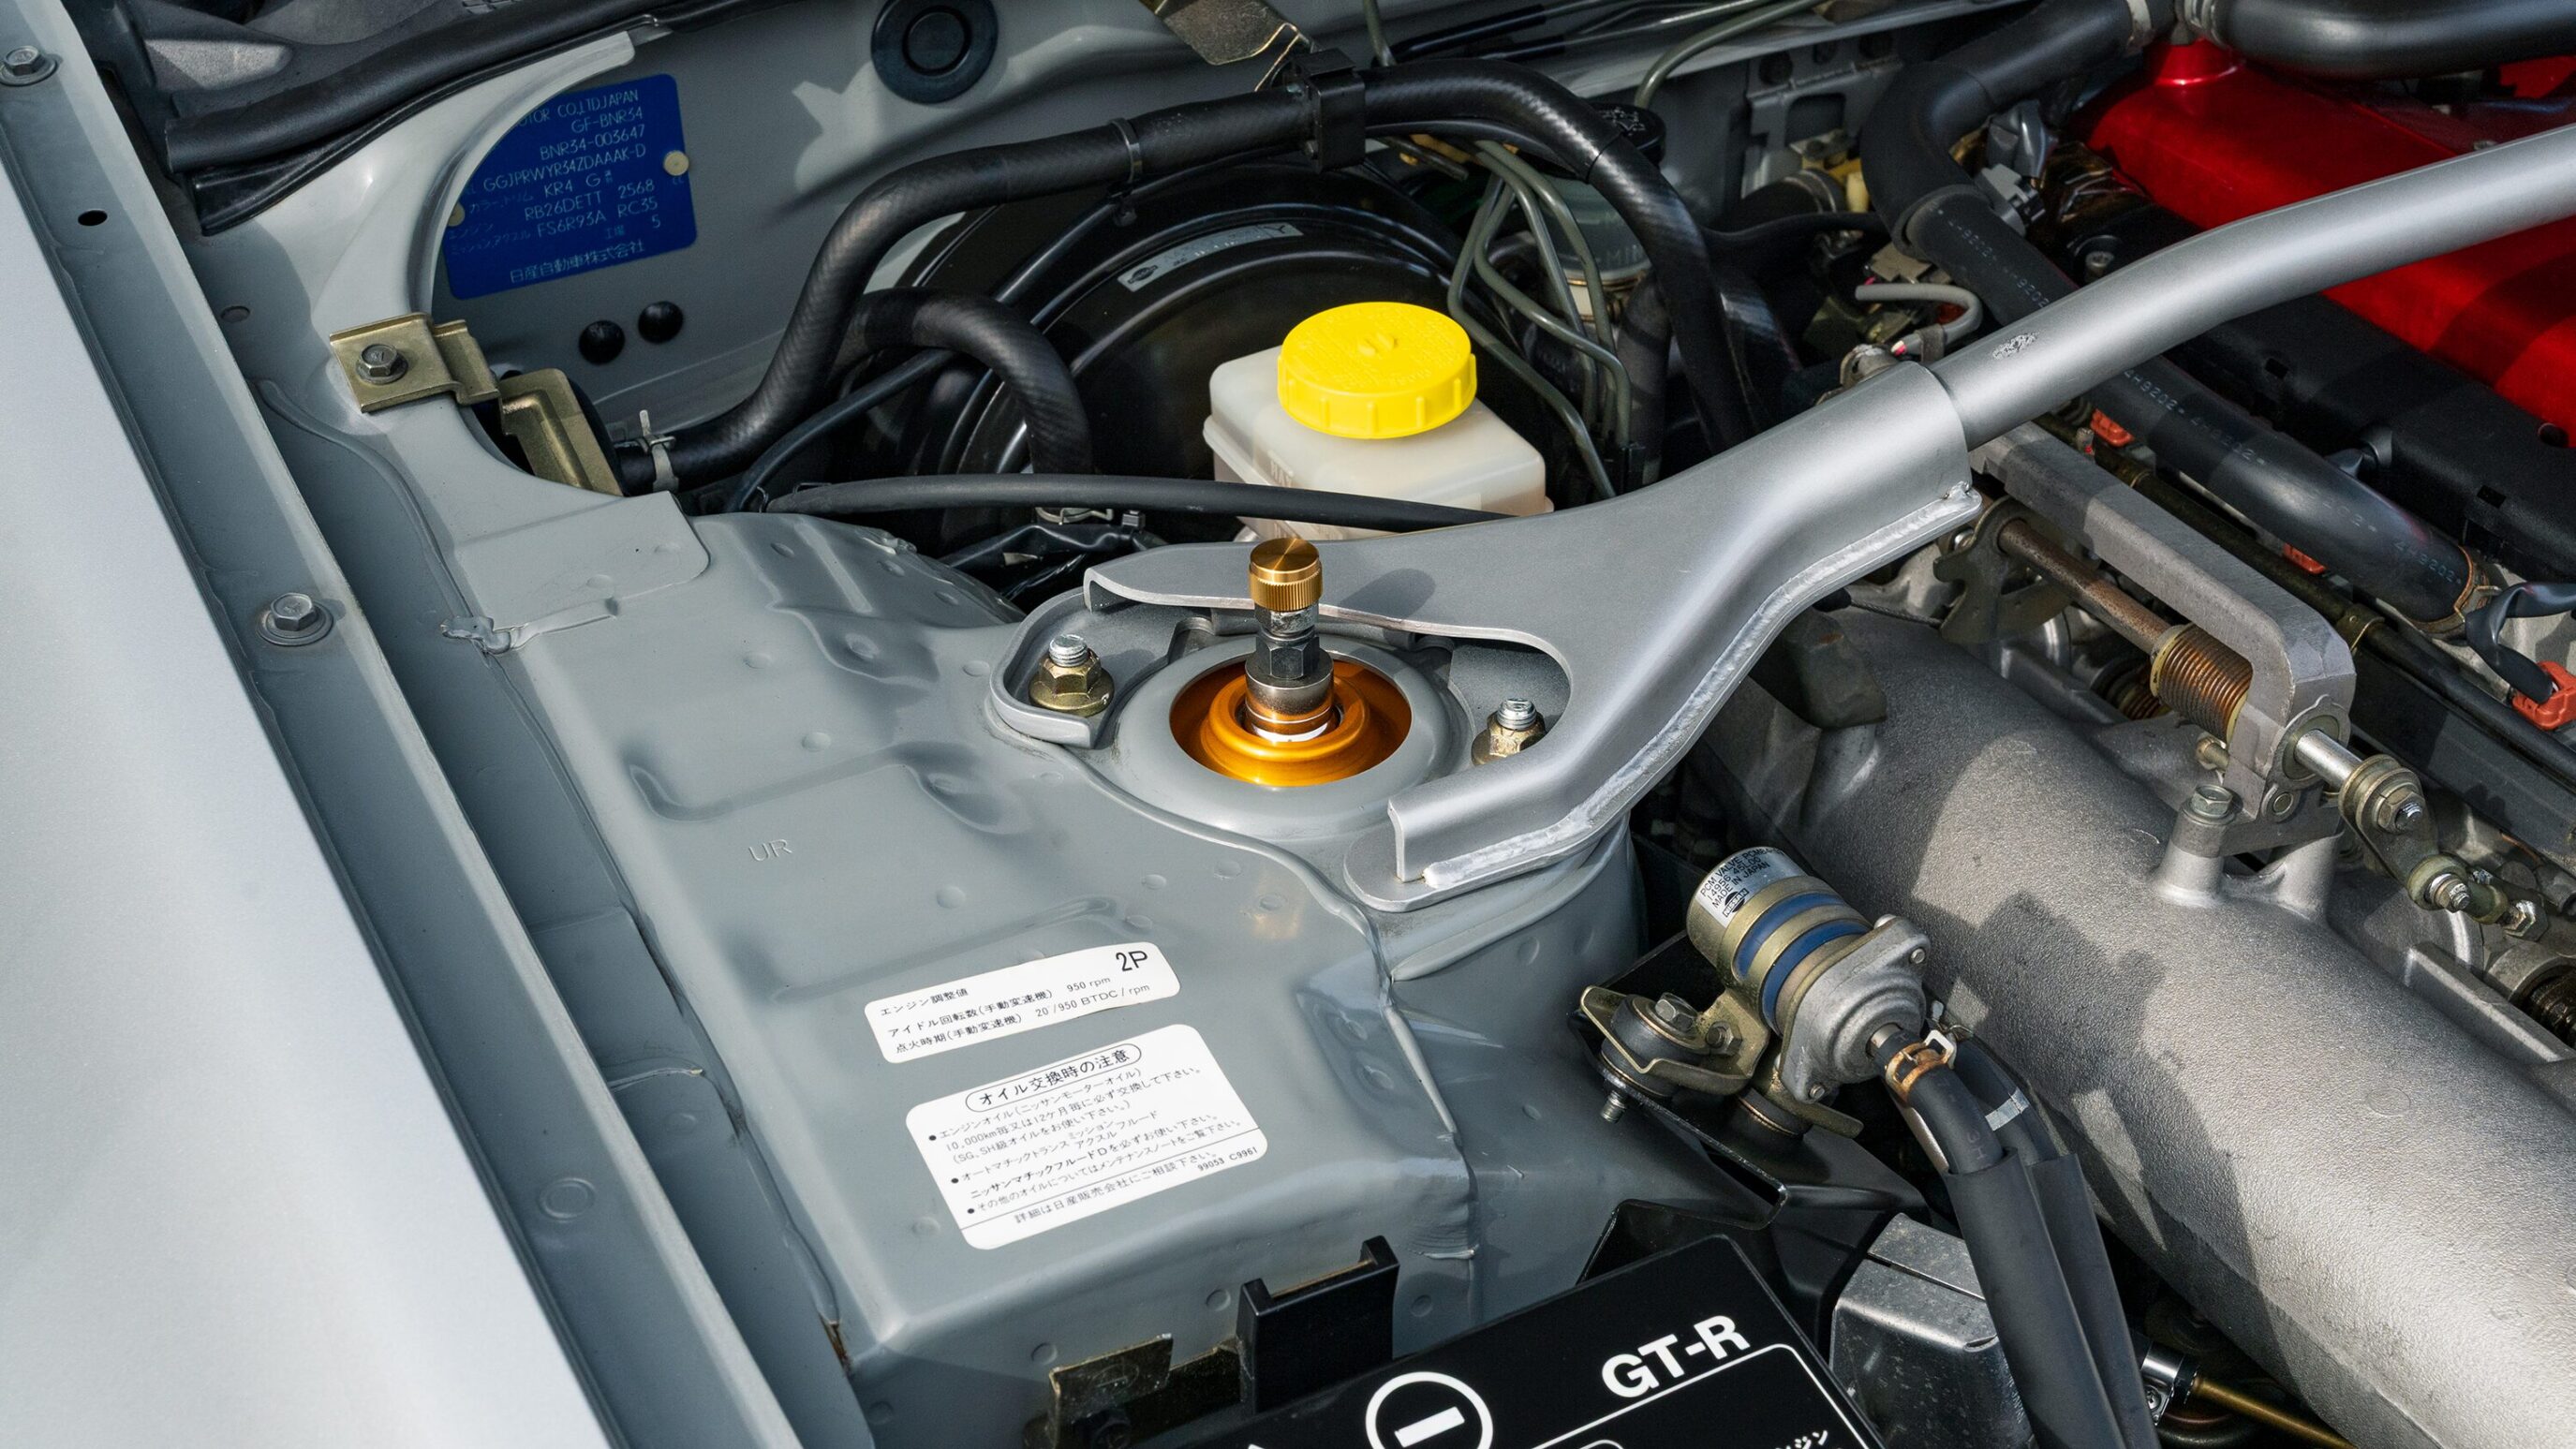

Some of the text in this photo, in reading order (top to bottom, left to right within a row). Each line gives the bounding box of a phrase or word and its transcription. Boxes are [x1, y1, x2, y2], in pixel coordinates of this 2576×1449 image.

[514, 109, 550, 127] OTOR
[571, 106, 644, 133] GF-BNR34
[540, 124, 645, 160] BNR34-003647
[525, 191, 603, 222] RB26DETT
[617, 179, 655, 200] 2568
[543, 180, 573, 199] KR4
[537, 197, 659, 239] FS6R93A RC35
[651, 214, 661, 229] 5
[510, 239, 645, 284] 日産自動車株式会社
[748, 839, 792, 861] UR
[1700, 877, 1716, 896] PCM
[1717, 856, 1742, 877] VALVE
[1709, 874, 1731, 899] 14956
[1711, 862, 1770, 909] MADE IN JAPAN
[1724, 889, 1748, 916] NISSAN
[1115, 950, 1148, 972] 2P
[1067, 982, 1087, 993] 950
[1088, 978, 1111, 990] rpm
[1080, 990, 1118, 1006] BTDC
[1128, 983, 1150, 997] rpm
[880, 988, 969, 1016] エンジン調整値
[979, 1048, 1130, 1106] オイル交換時の注意
[1197, 1146, 1258, 1173] 99053 C9961
[1601, 1315, 1751, 1397] GT-R
